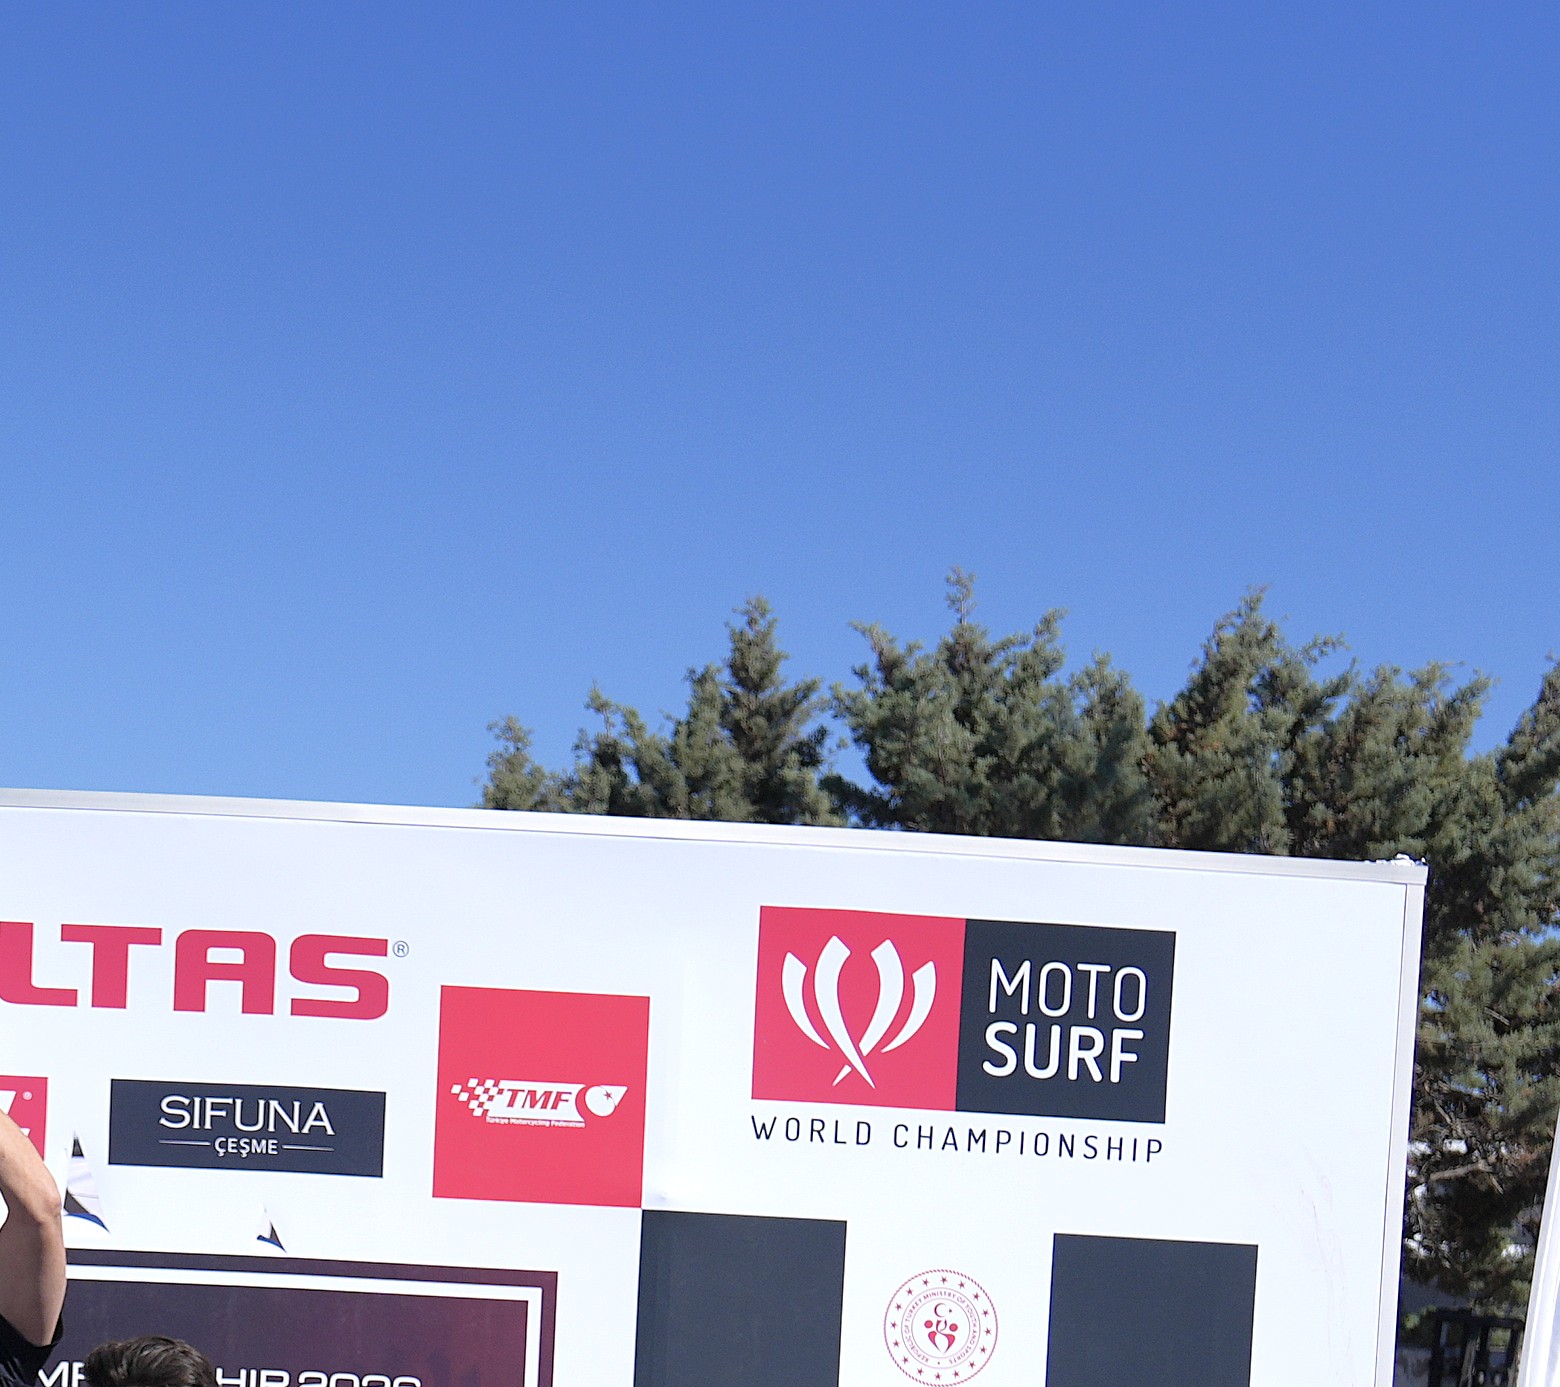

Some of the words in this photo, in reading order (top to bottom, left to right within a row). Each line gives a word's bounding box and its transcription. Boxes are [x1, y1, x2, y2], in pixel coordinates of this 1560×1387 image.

[987, 958, 1148, 1022] MOTO
[980, 1021, 1145, 1085] SURF
[158, 1094, 337, 1136] SIFUNA
[503, 1088, 573, 1110] TMF
[213, 1136, 280, 1158] ÇEŞME
[751, 1115, 872, 1147] WORLD
[892, 1122, 1164, 1163] CHAMPIONSHIP
